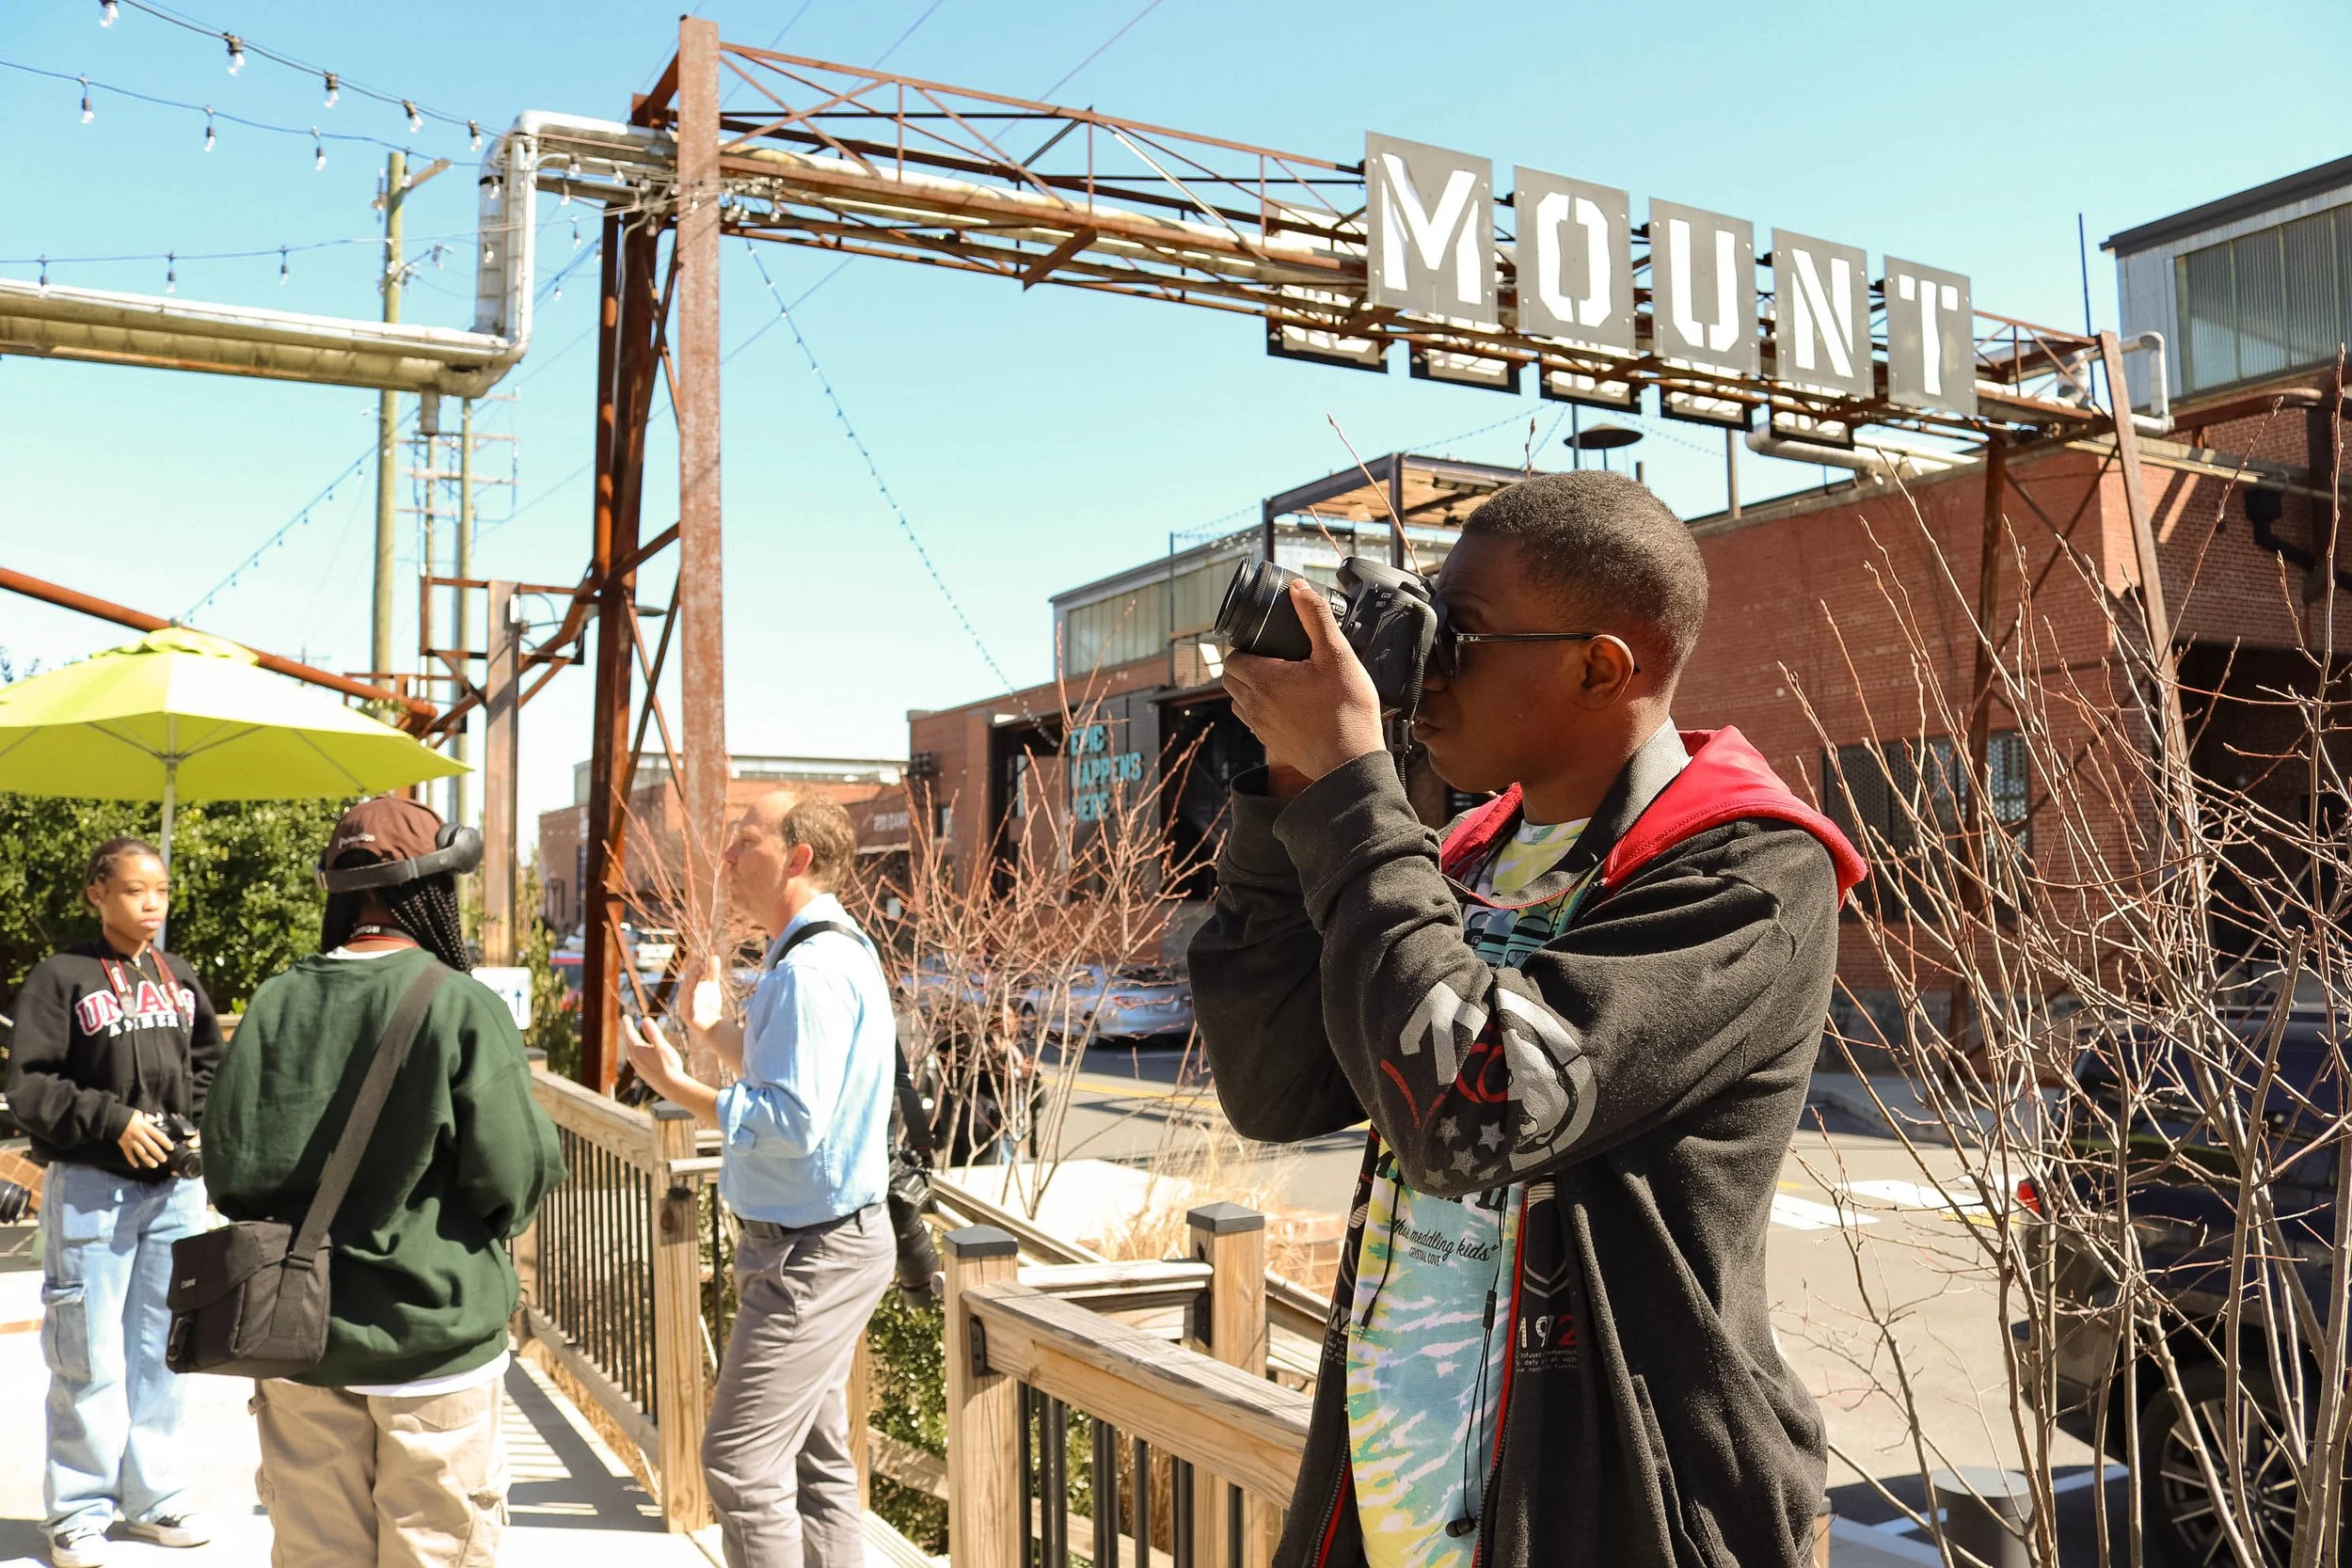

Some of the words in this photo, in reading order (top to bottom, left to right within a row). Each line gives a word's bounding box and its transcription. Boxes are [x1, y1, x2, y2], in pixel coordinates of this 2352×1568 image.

[1380, 152, 1959, 396] MOUNT
[1408, 1246, 1426, 1262] CRYSTAL
[1427, 1252, 1441, 1266] COVE
[1409, 1229, 1454, 1261] meddling
[1456, 1237, 1500, 1261] kids"
